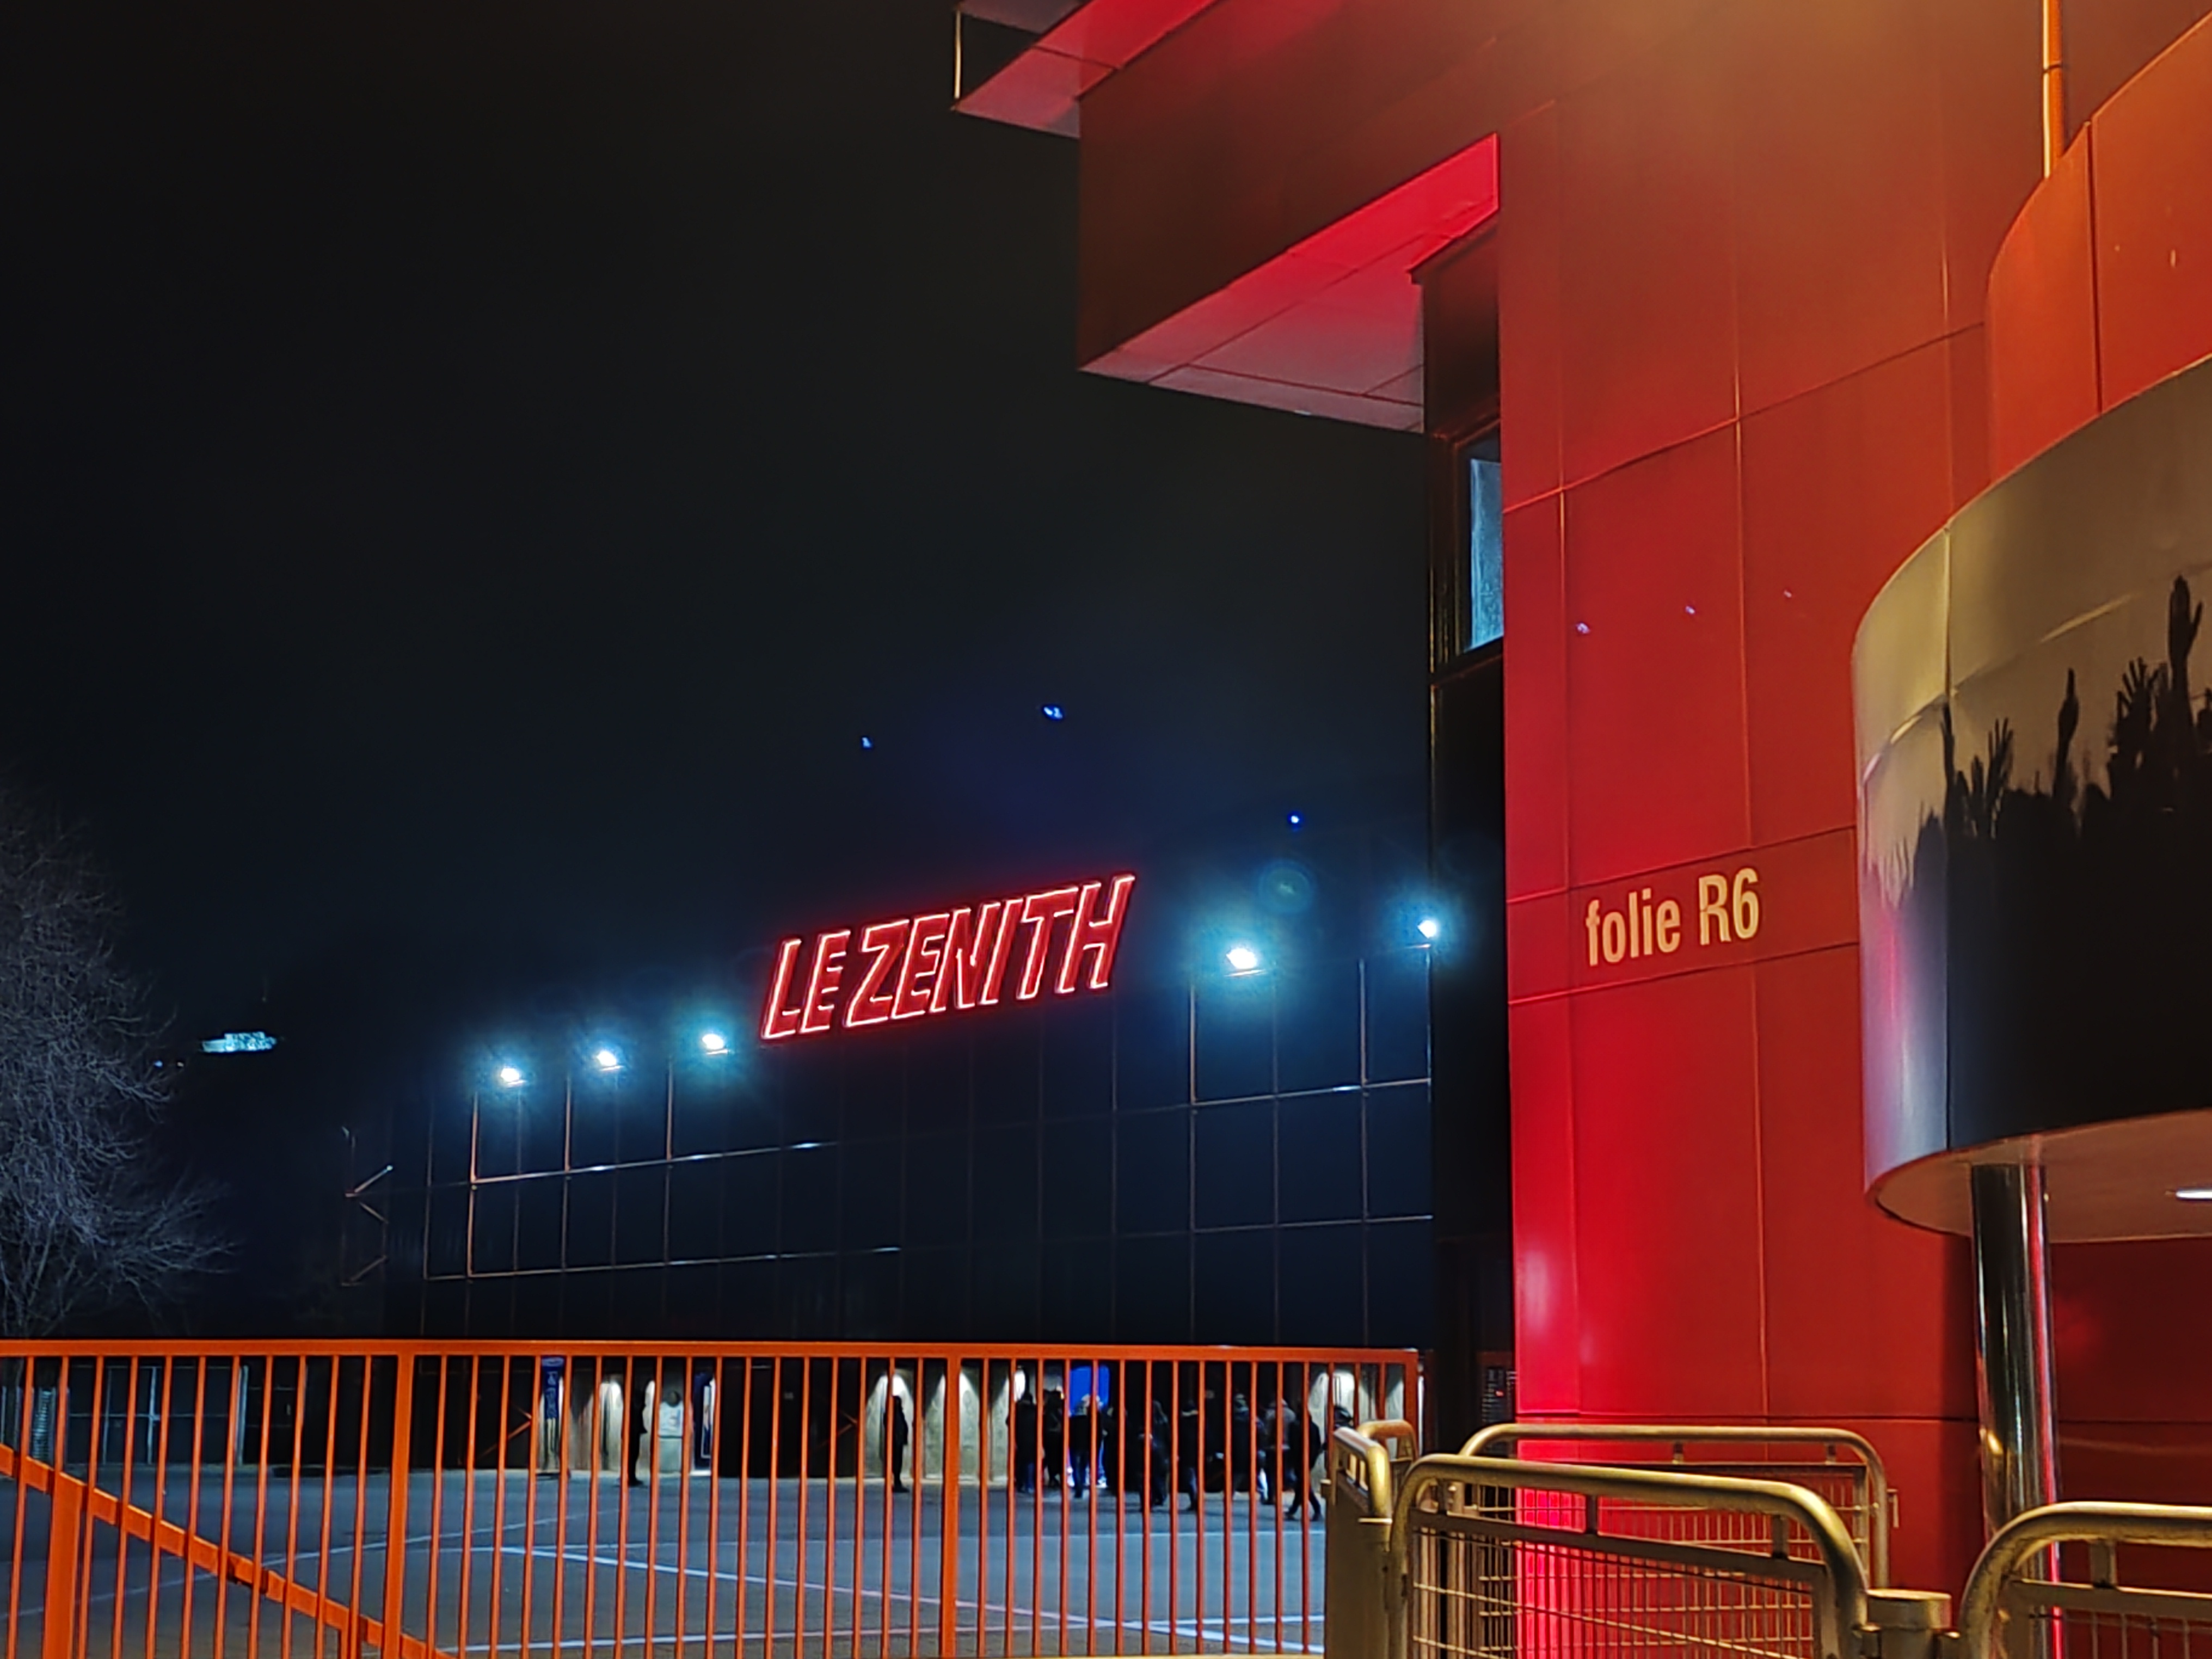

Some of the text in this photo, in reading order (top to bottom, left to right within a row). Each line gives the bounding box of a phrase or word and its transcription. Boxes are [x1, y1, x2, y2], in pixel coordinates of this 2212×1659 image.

[761, 875, 1135, 1039] LE ZENITH
[1586, 868, 1759, 966] folie R6
